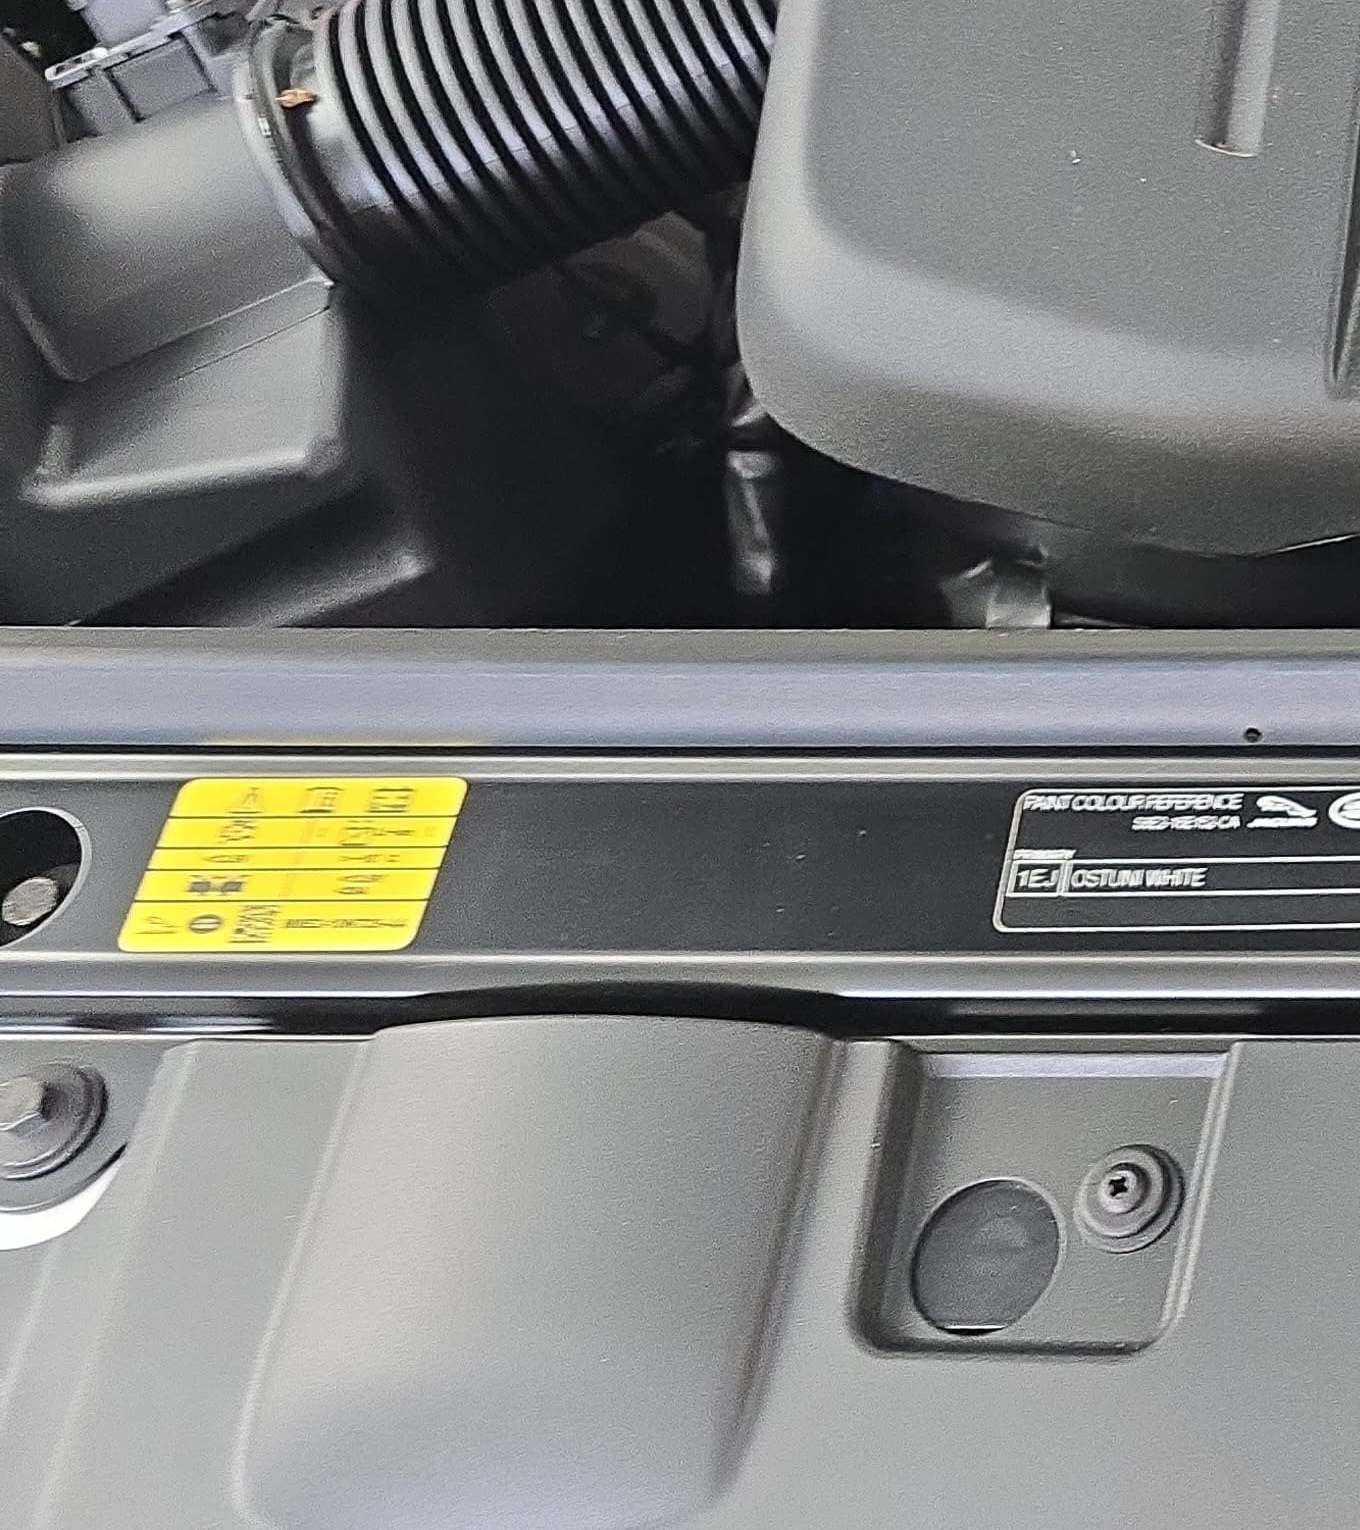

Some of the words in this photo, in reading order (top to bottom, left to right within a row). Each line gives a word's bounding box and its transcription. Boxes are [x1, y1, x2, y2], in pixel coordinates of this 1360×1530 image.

[1022, 794, 1074, 811] PAINT
[1071, 794, 1145, 811] COLOUR
[1017, 868, 1060, 887] 1EJ
[1070, 868, 1145, 888] OSTUNI
[1144, 867, 1209, 887] WHITE
